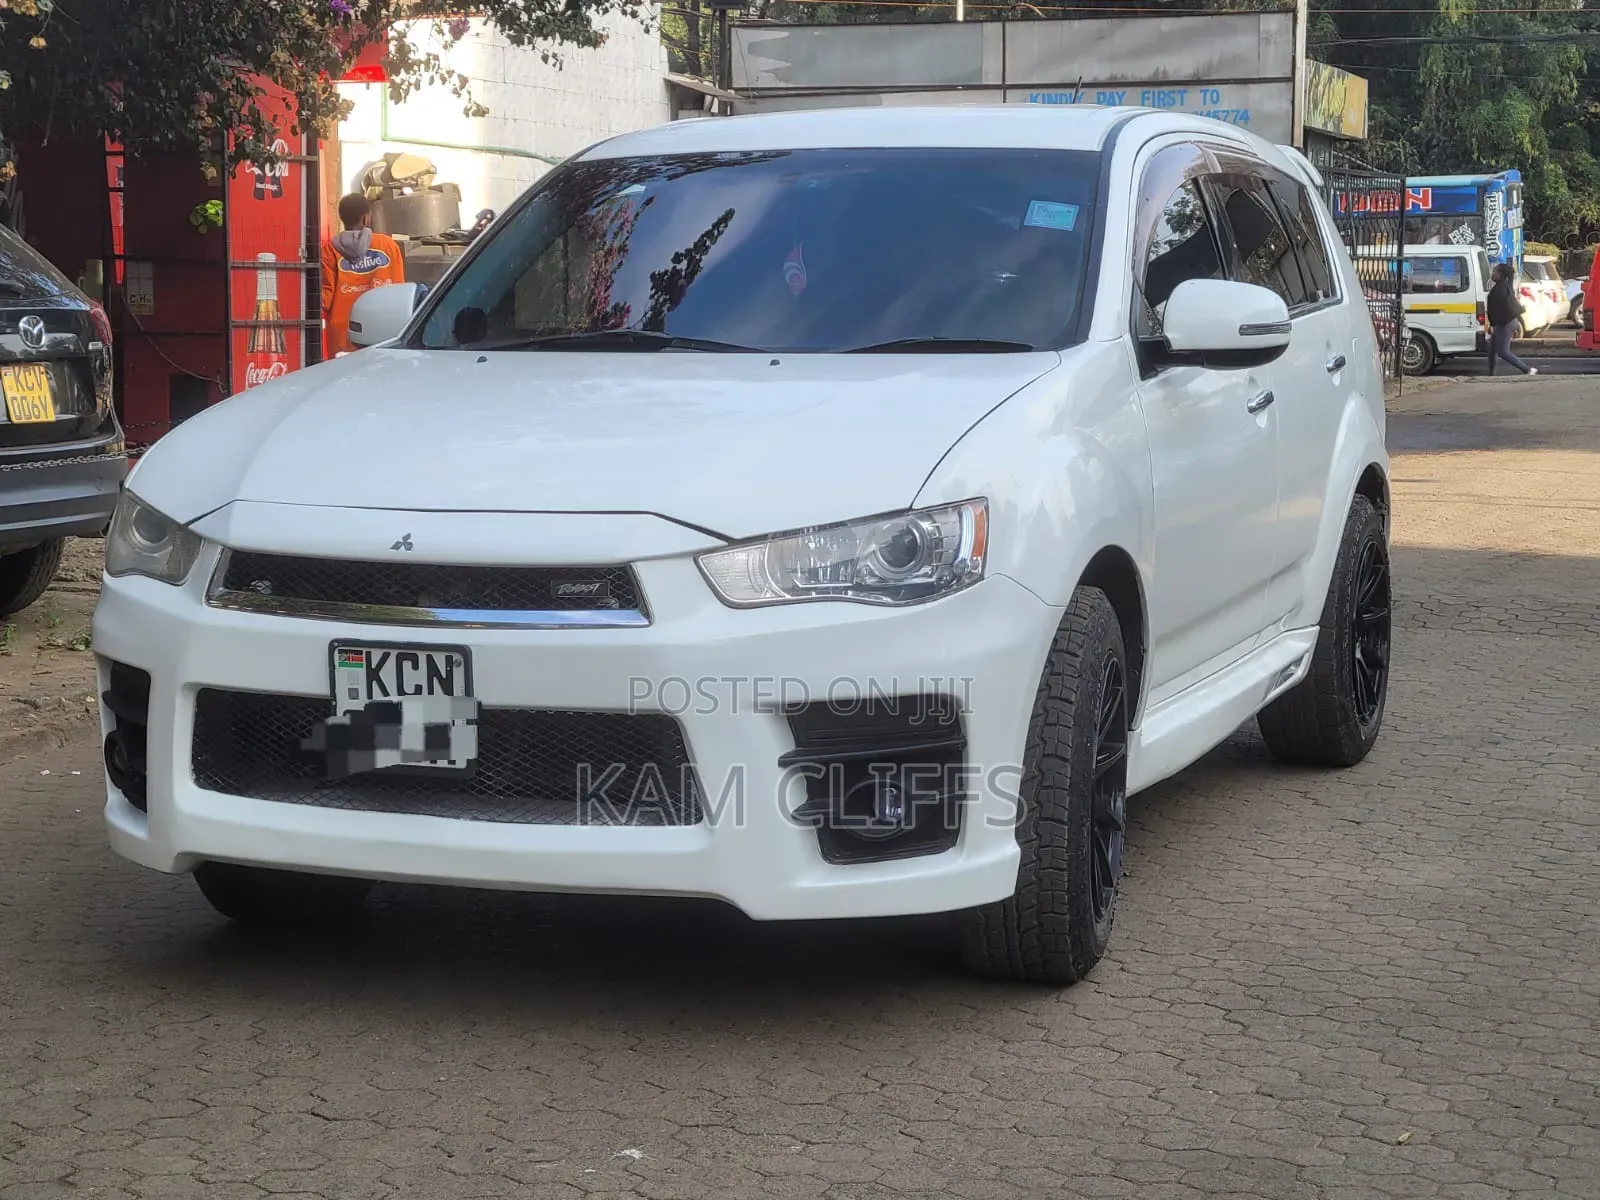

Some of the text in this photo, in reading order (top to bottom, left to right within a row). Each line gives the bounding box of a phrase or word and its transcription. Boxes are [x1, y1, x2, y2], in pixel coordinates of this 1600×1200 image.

[1096, 91, 1126, 106] PAY
[1141, 89, 1188, 108] FIRST
[1200, 88, 1220, 106] TO
[351, 255, 382, 270] estive
[13, 366, 43, 392] KCV
[365, 650, 454, 700] KCN
